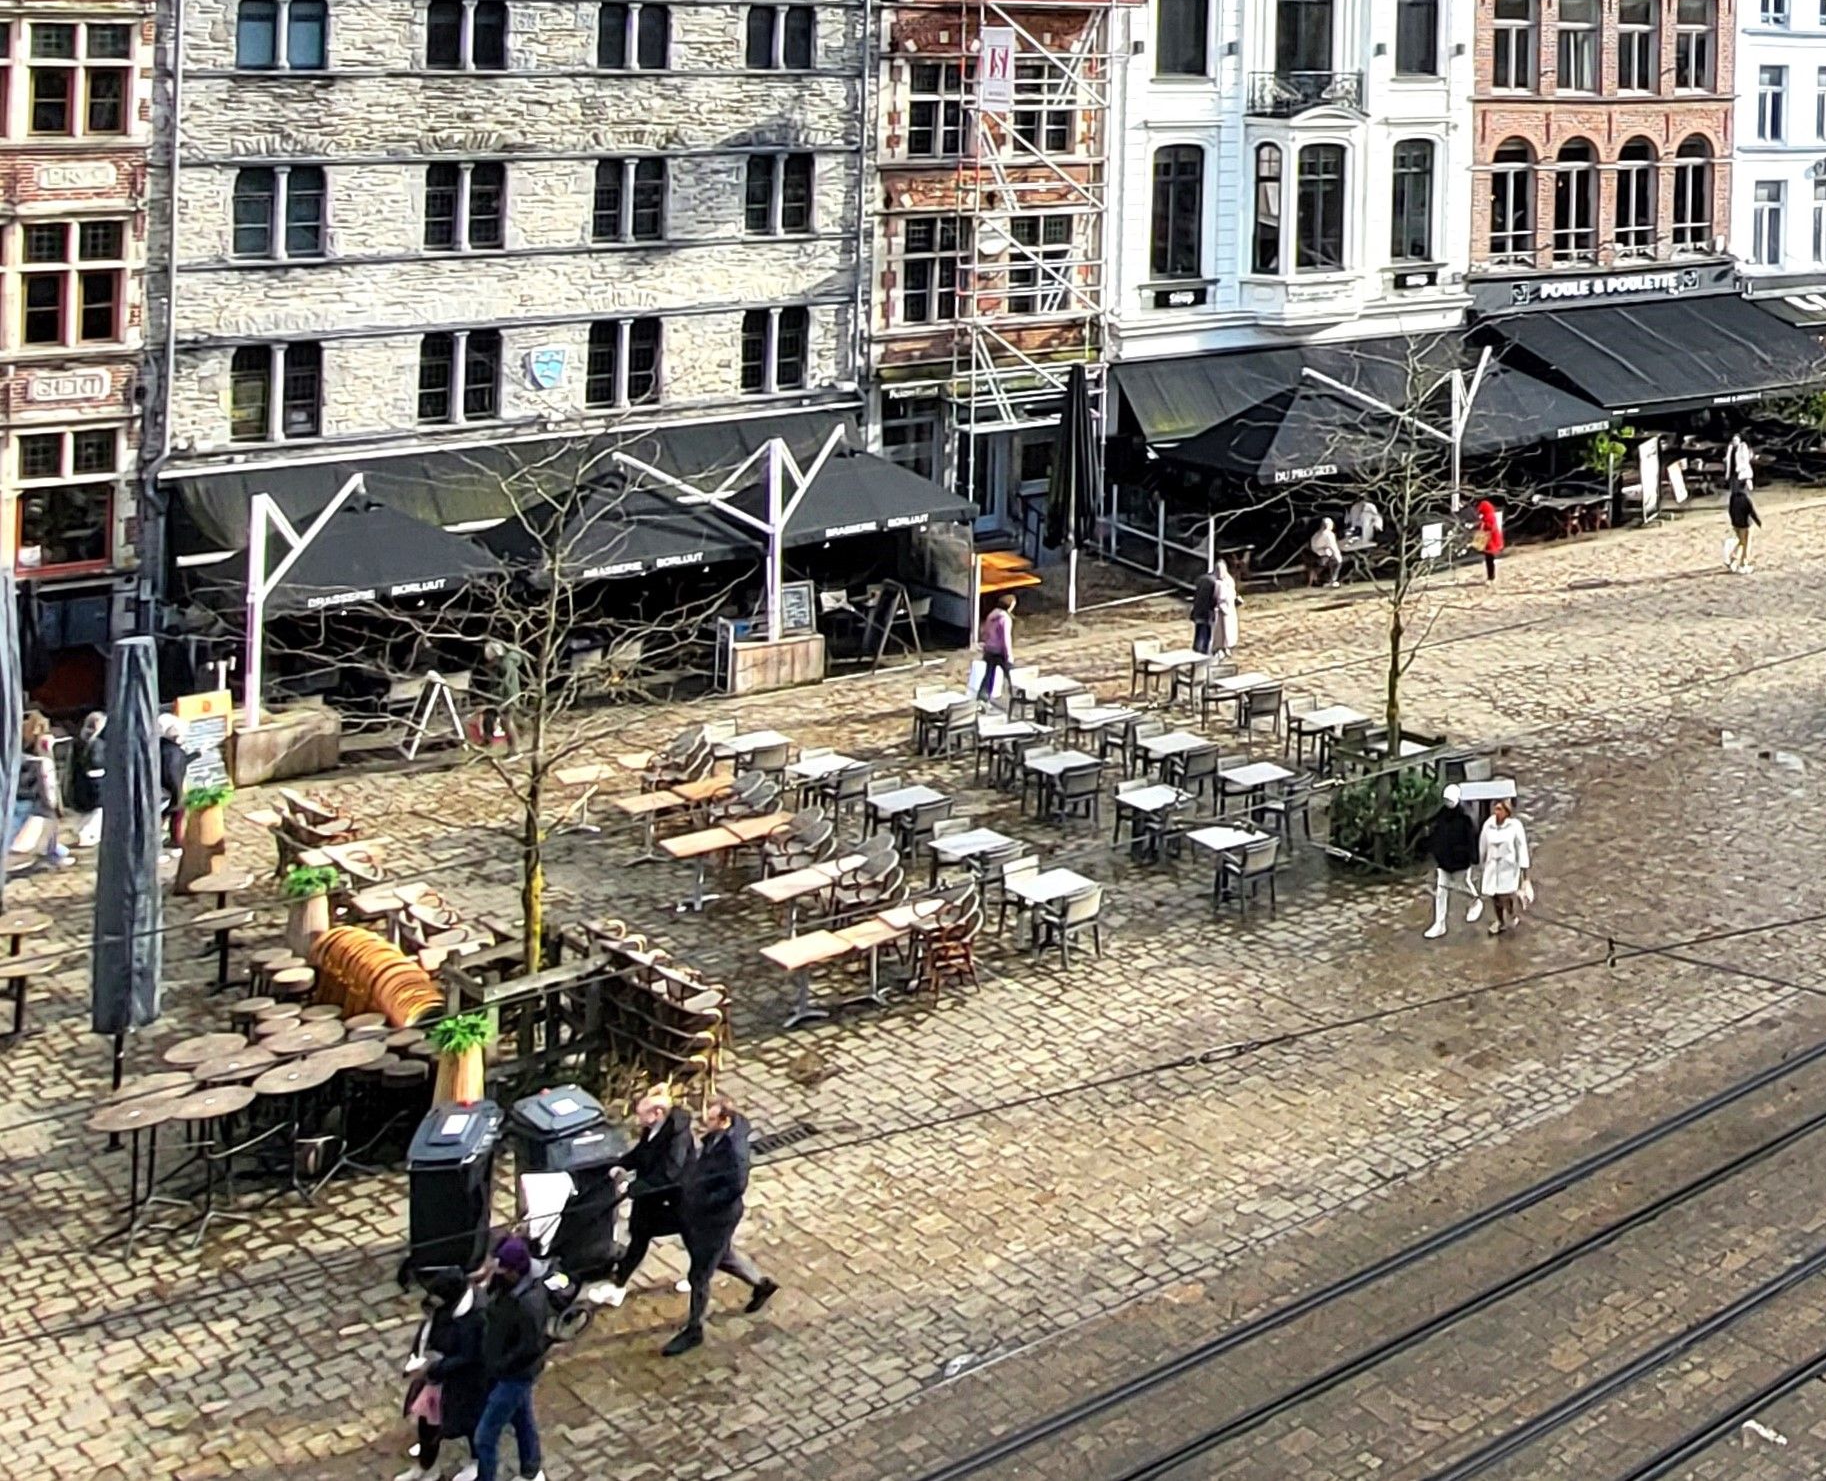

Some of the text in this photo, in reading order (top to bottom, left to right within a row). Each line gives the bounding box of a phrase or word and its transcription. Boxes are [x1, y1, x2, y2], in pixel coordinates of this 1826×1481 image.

[1540, 272, 1678, 299] POULE & POULETTE
[1274, 471, 1289, 483] DU
